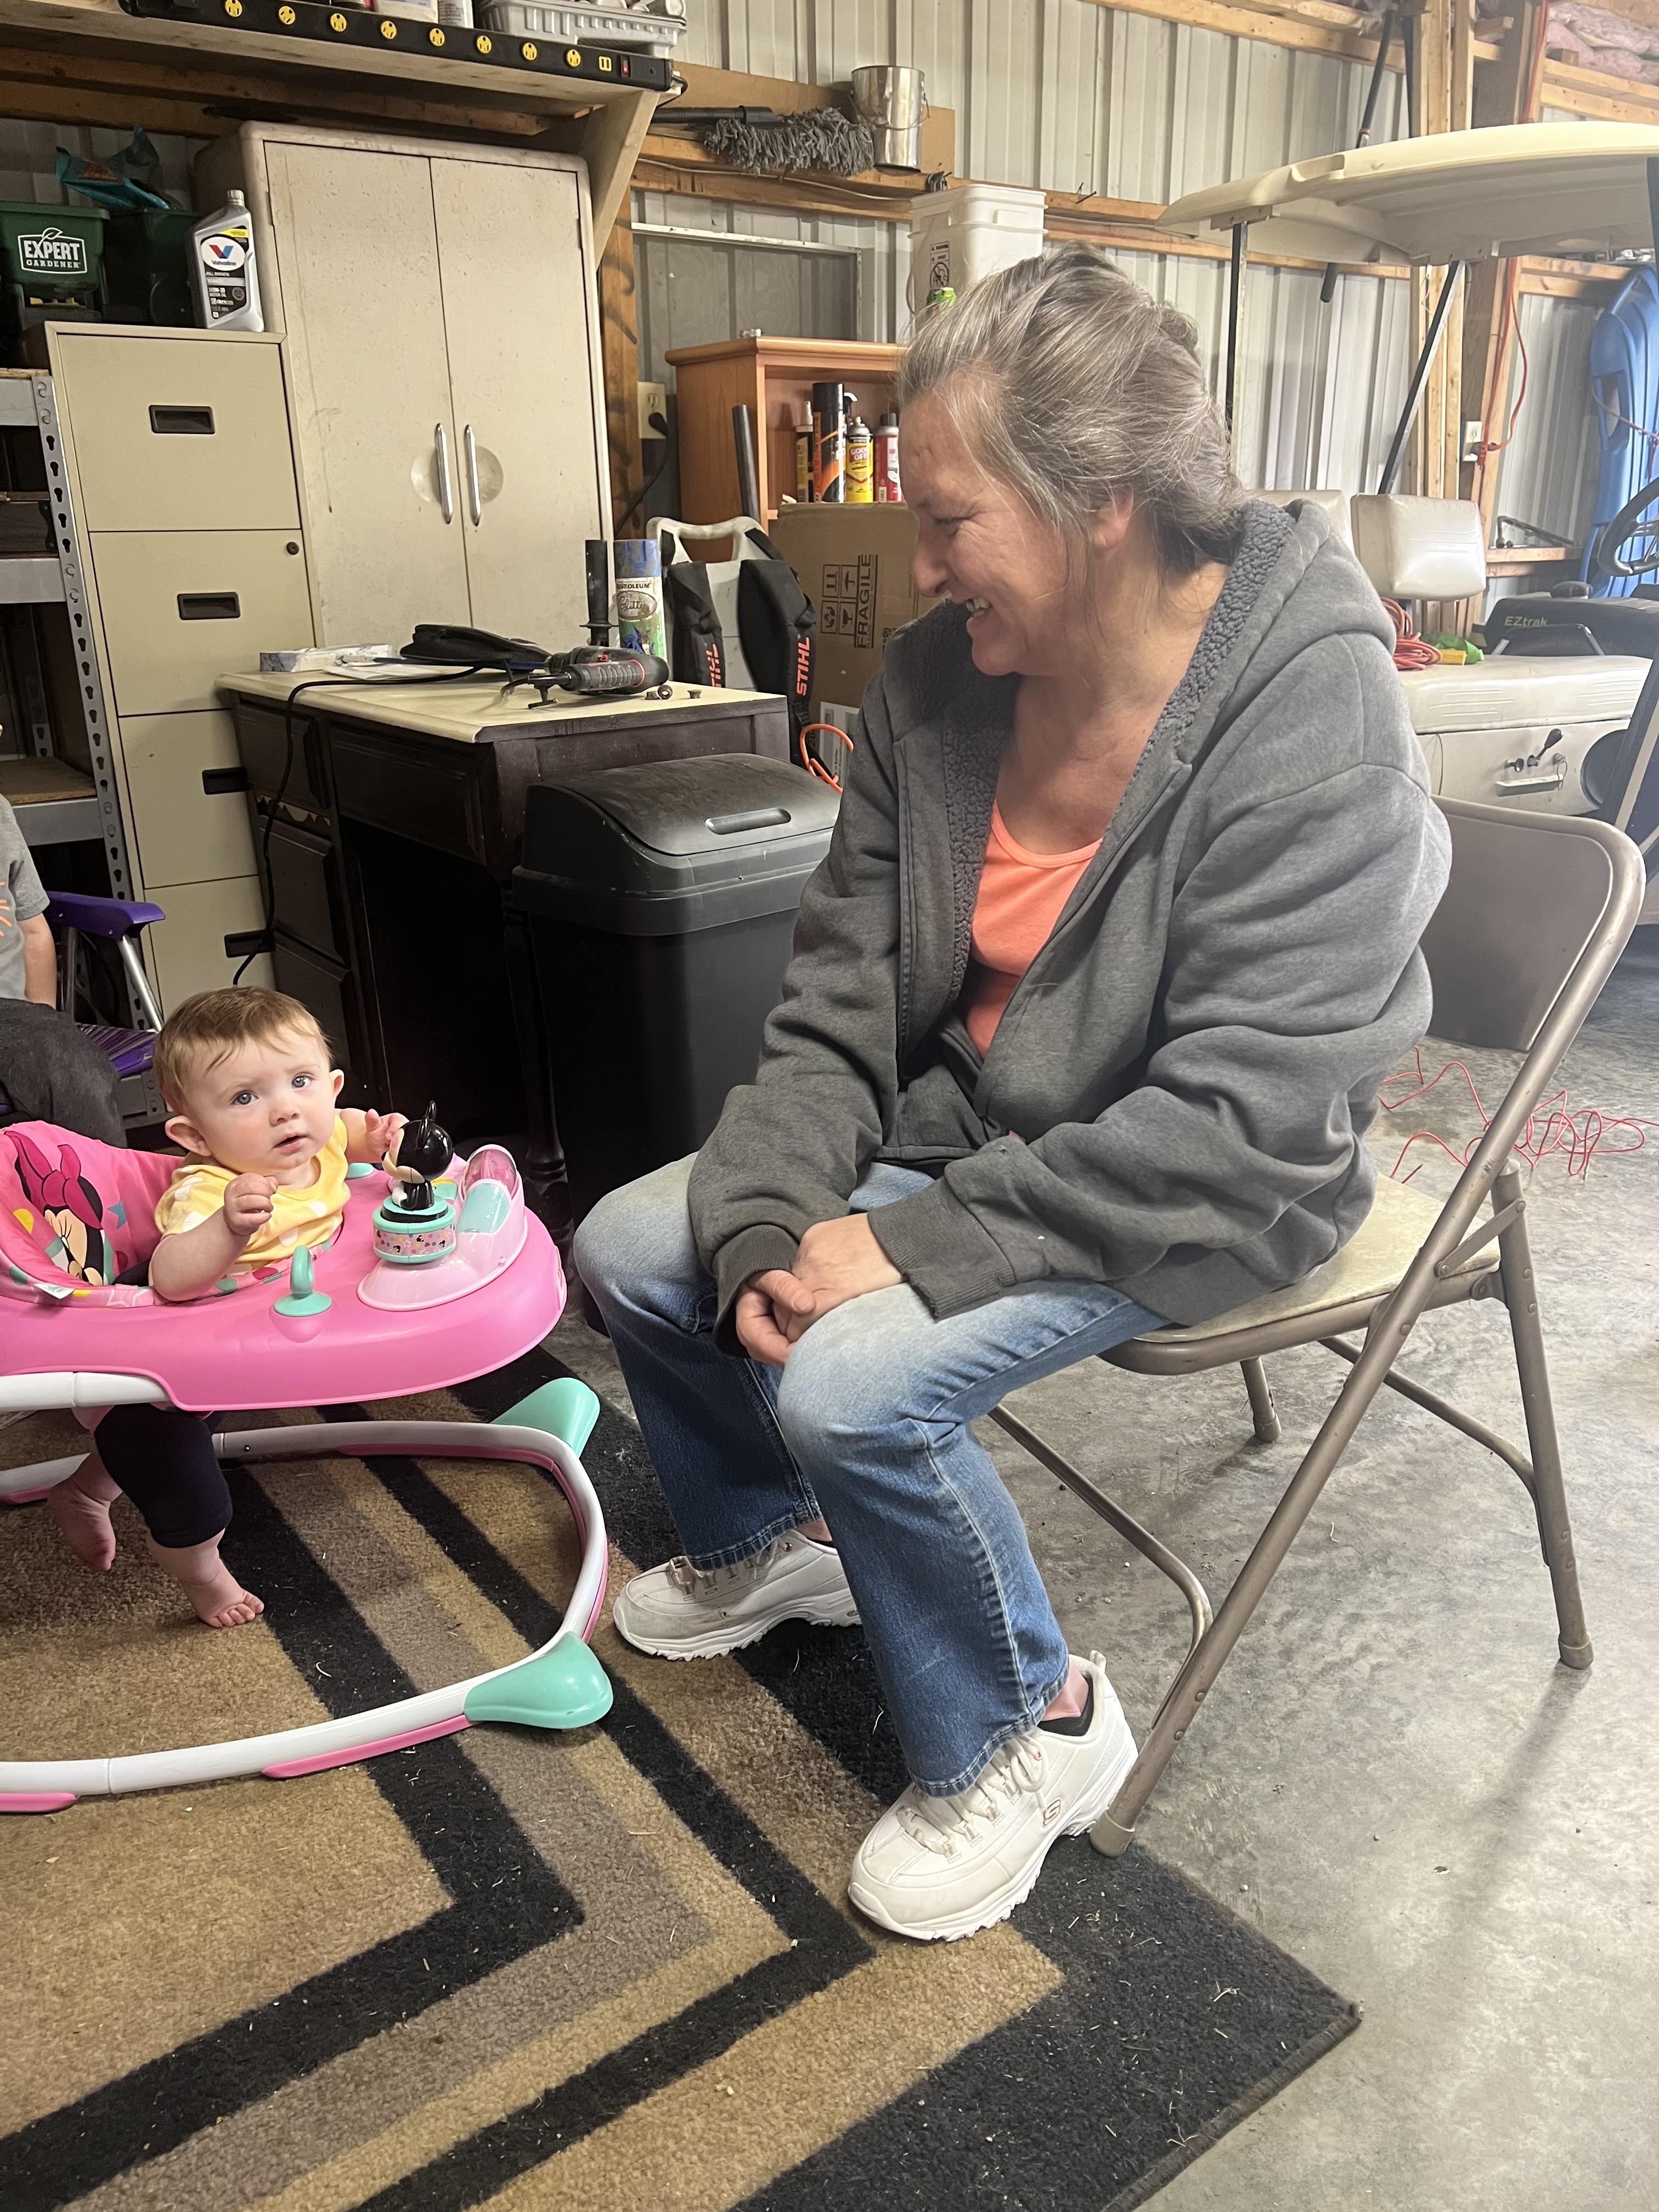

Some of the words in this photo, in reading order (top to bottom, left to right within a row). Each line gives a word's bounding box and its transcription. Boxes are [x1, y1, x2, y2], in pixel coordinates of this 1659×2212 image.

[24, 240, 80, 261] EXPERT
[26, 259, 80, 268] GARDENER
[857, 554, 871, 649] FRAGILE
[1504, 616, 1548, 627] EZtrak
[706, 644, 722, 687] TIHL
[797, 636, 810, 696] STIHL
